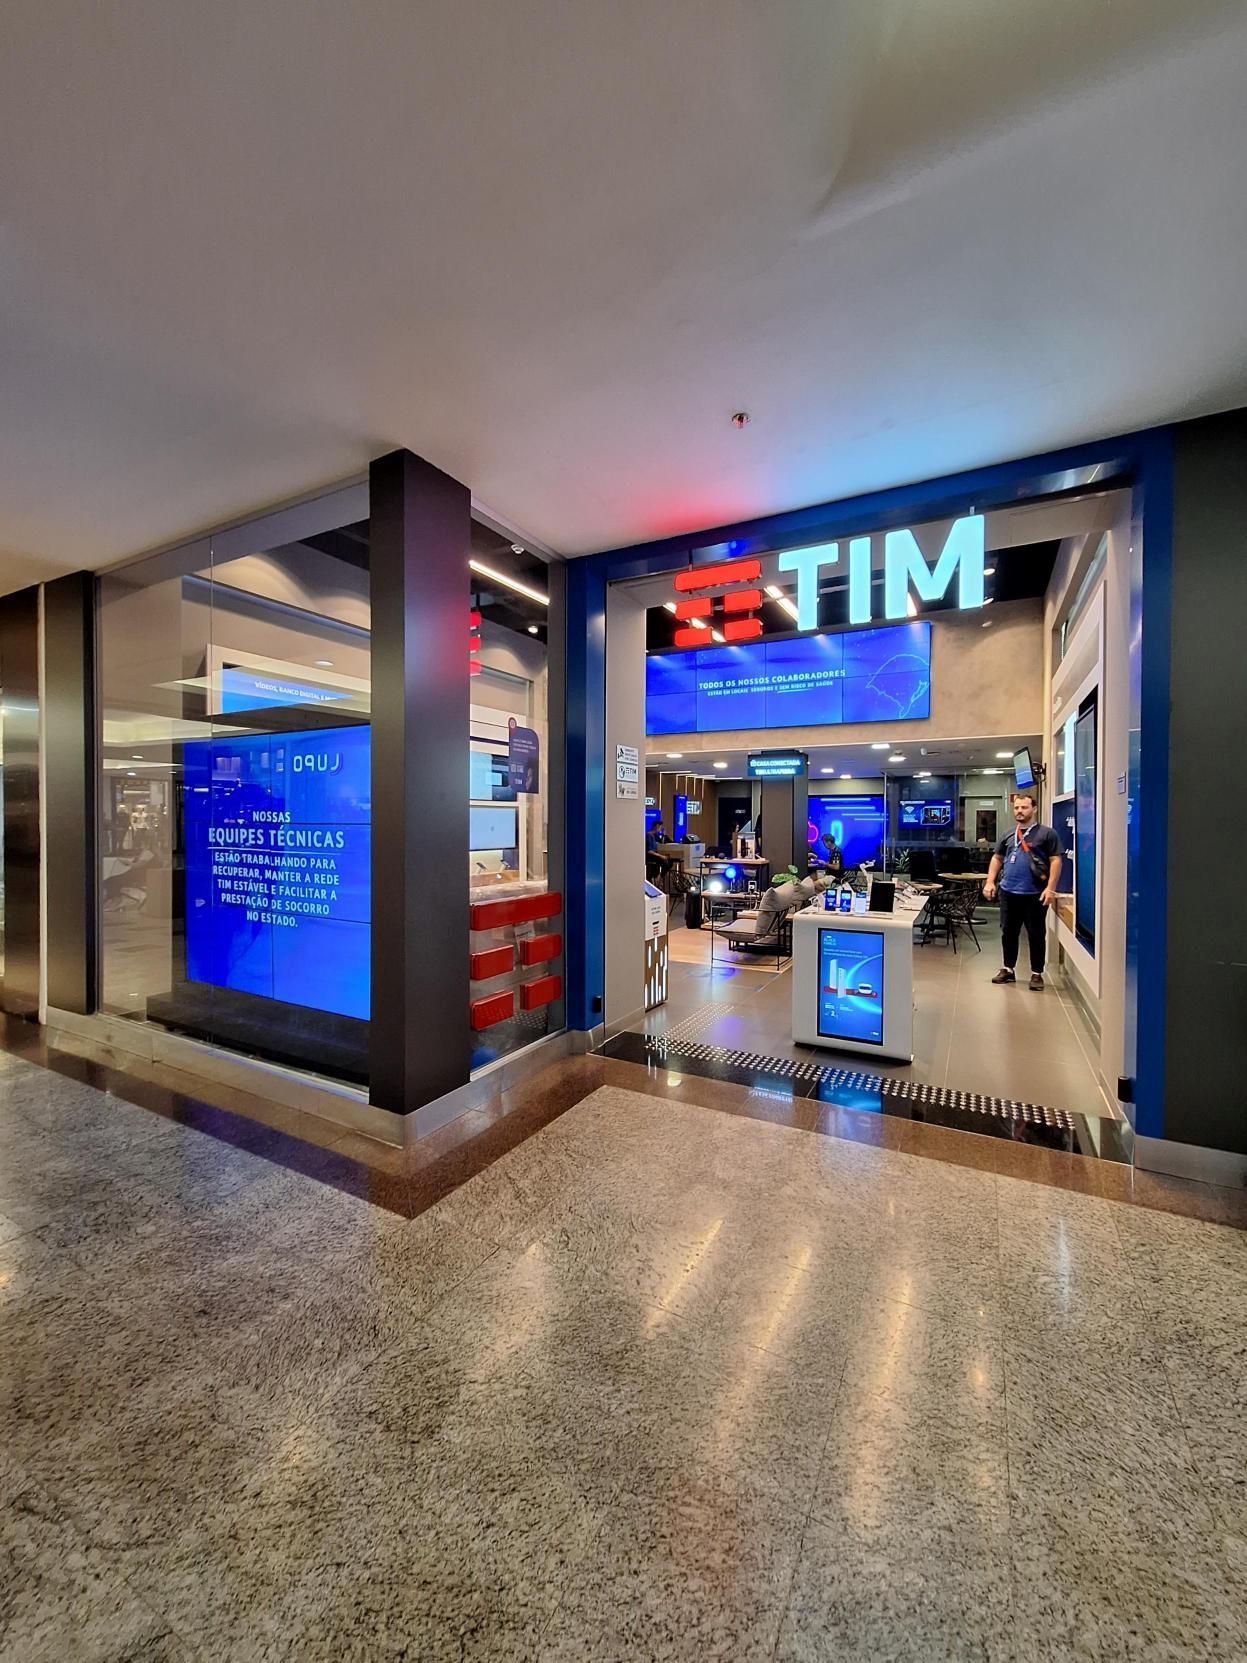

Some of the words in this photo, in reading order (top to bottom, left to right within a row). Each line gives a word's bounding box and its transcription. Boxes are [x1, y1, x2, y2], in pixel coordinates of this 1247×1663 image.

[778, 514, 985, 631] TIM
[699, 681, 724, 690] TODOS
[738, 677, 770, 686] NOSSOS
[772, 669, 846, 683] COLABORADORES
[252, 810, 291, 823] NOSSAS
[208, 827, 264, 847] EQUIPES
[268, 825, 345, 848] TÉCNICAS
[214, 850, 240, 863] ESTÃO
[241, 854, 307, 868] TRABALHANDO
[310, 858, 336, 870] PARA
[212, 865, 263, 881] RECUPERAR,
[265, 869, 301, 883] MANTER
[304, 873, 311, 883] A
[314, 874, 340, 886] REDE
[217, 879, 232, 889] TIM
[233, 879, 269, 894] ESTÁVEL
[271, 885, 277, 895] E
[279, 885, 327, 900] FACILITAR
[330, 890, 337, 901] A
[221, 892, 269, 908] PRESTAÇÃO
[271, 899, 283, 910] DE
[285, 900, 330, 915] SOCORRO
[246, 910, 259, 922] NO
[261, 912, 298, 928] ESTADO.
